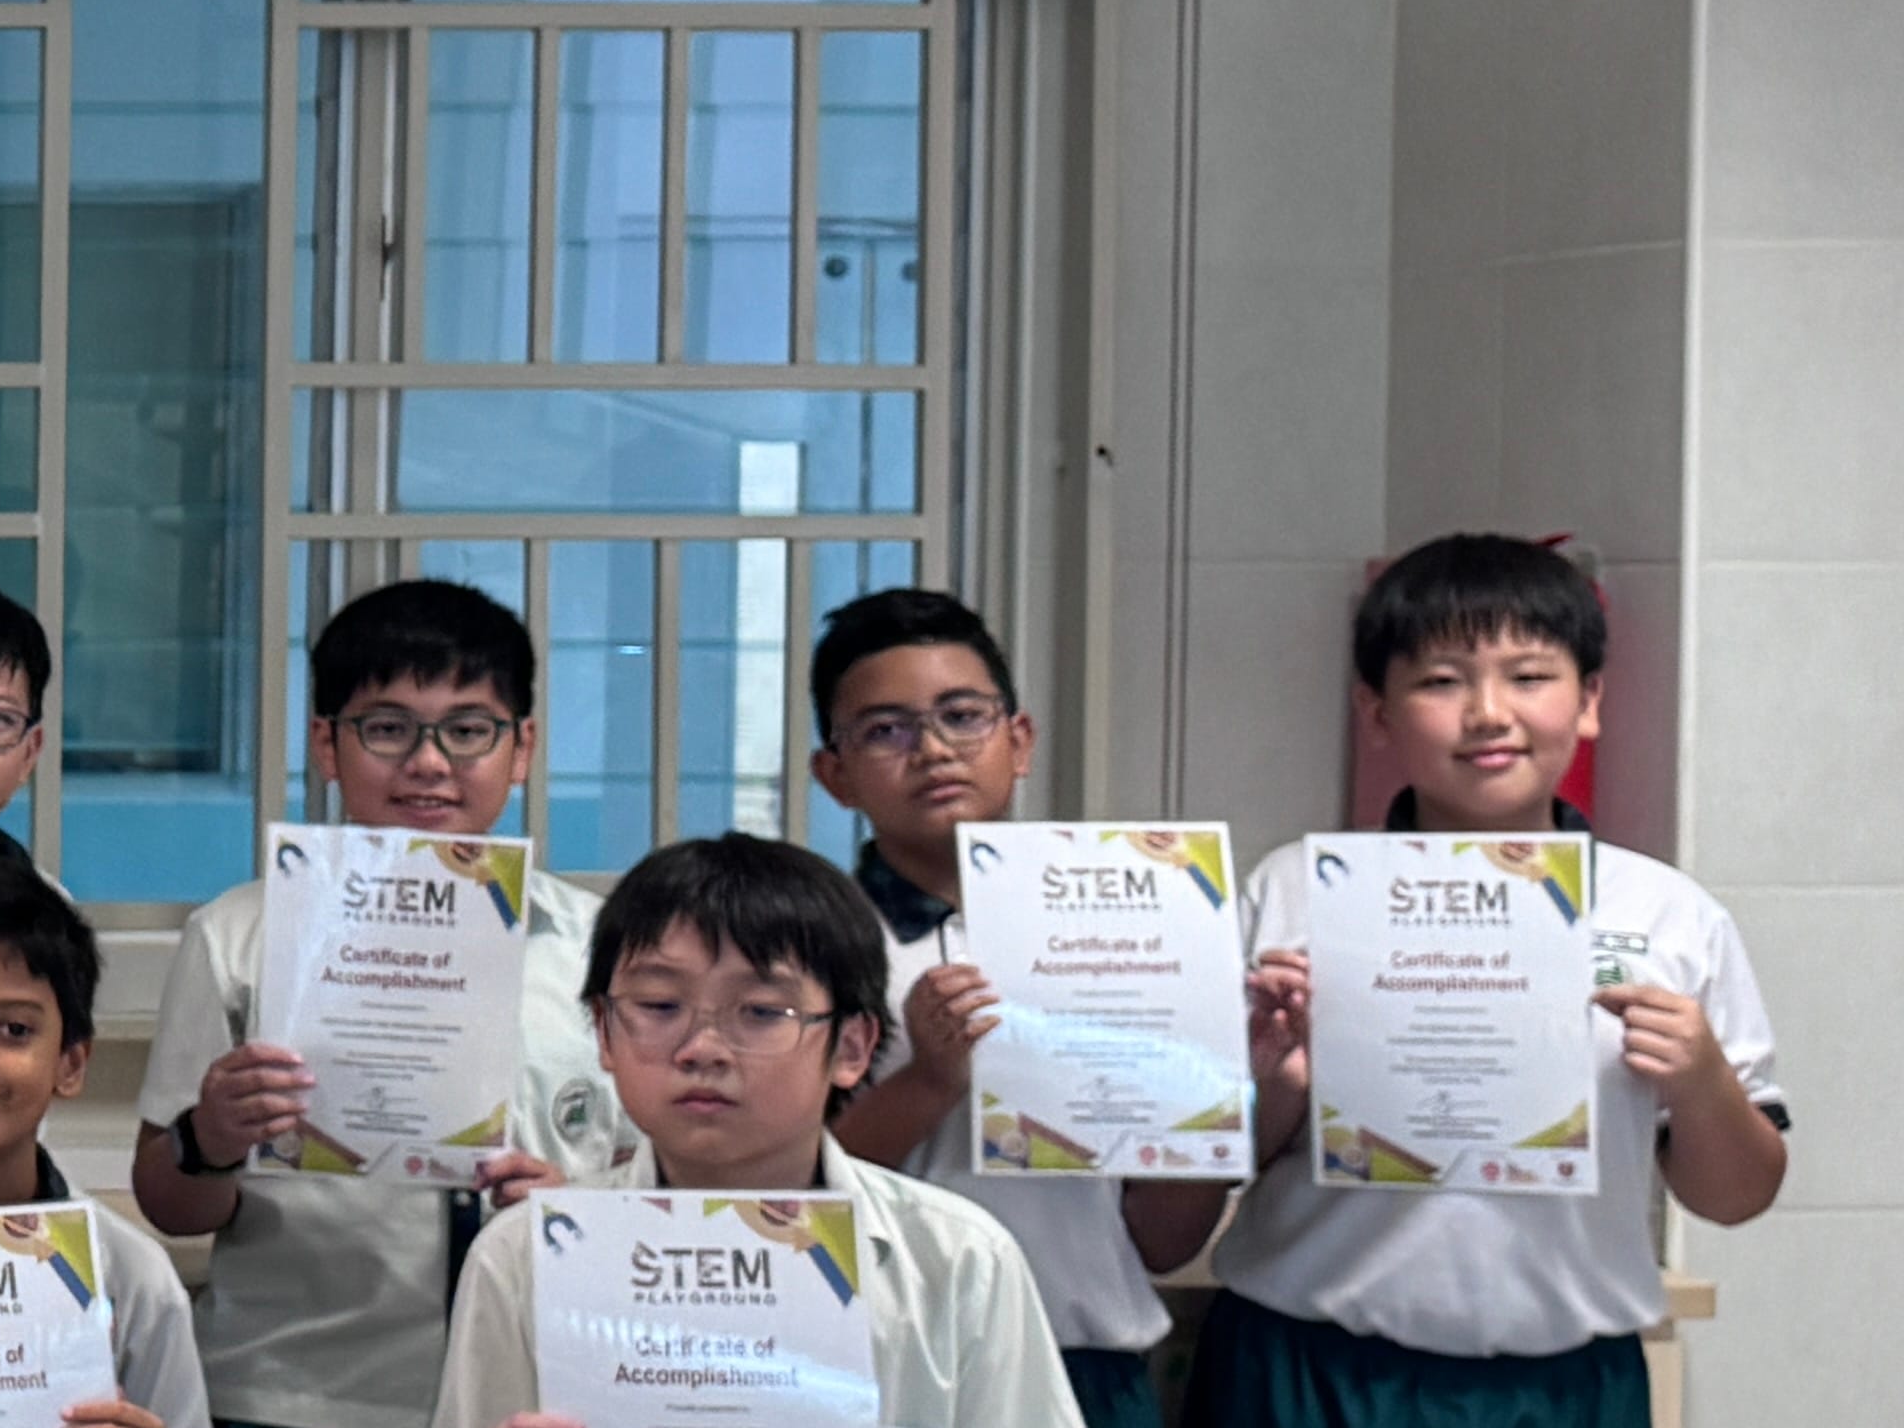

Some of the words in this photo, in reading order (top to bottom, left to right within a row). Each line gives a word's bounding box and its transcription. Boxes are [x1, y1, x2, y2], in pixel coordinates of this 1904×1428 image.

[1042, 864, 1158, 899] STEM
[343, 871, 456, 914] STEM
[1388, 876, 1508, 915] STEM
[1047, 935, 1139, 952] Certificate
[1143, 935, 1163, 952] of
[340, 945, 428, 968] Certificate
[432, 950, 450, 968] of
[1390, 950, 1486, 969] Certificate
[1490, 950, 1510, 968] of
[1031, 958, 1181, 978] Accomplishment
[321, 968, 466, 992] Accomplishment
[1372, 974, 1530, 994] Accomplishment
[631, 1240, 773, 1290] STEM
[633, 1292, 776, 1306] PLAYGROUND
[6, 1344, 25, 1364] of
